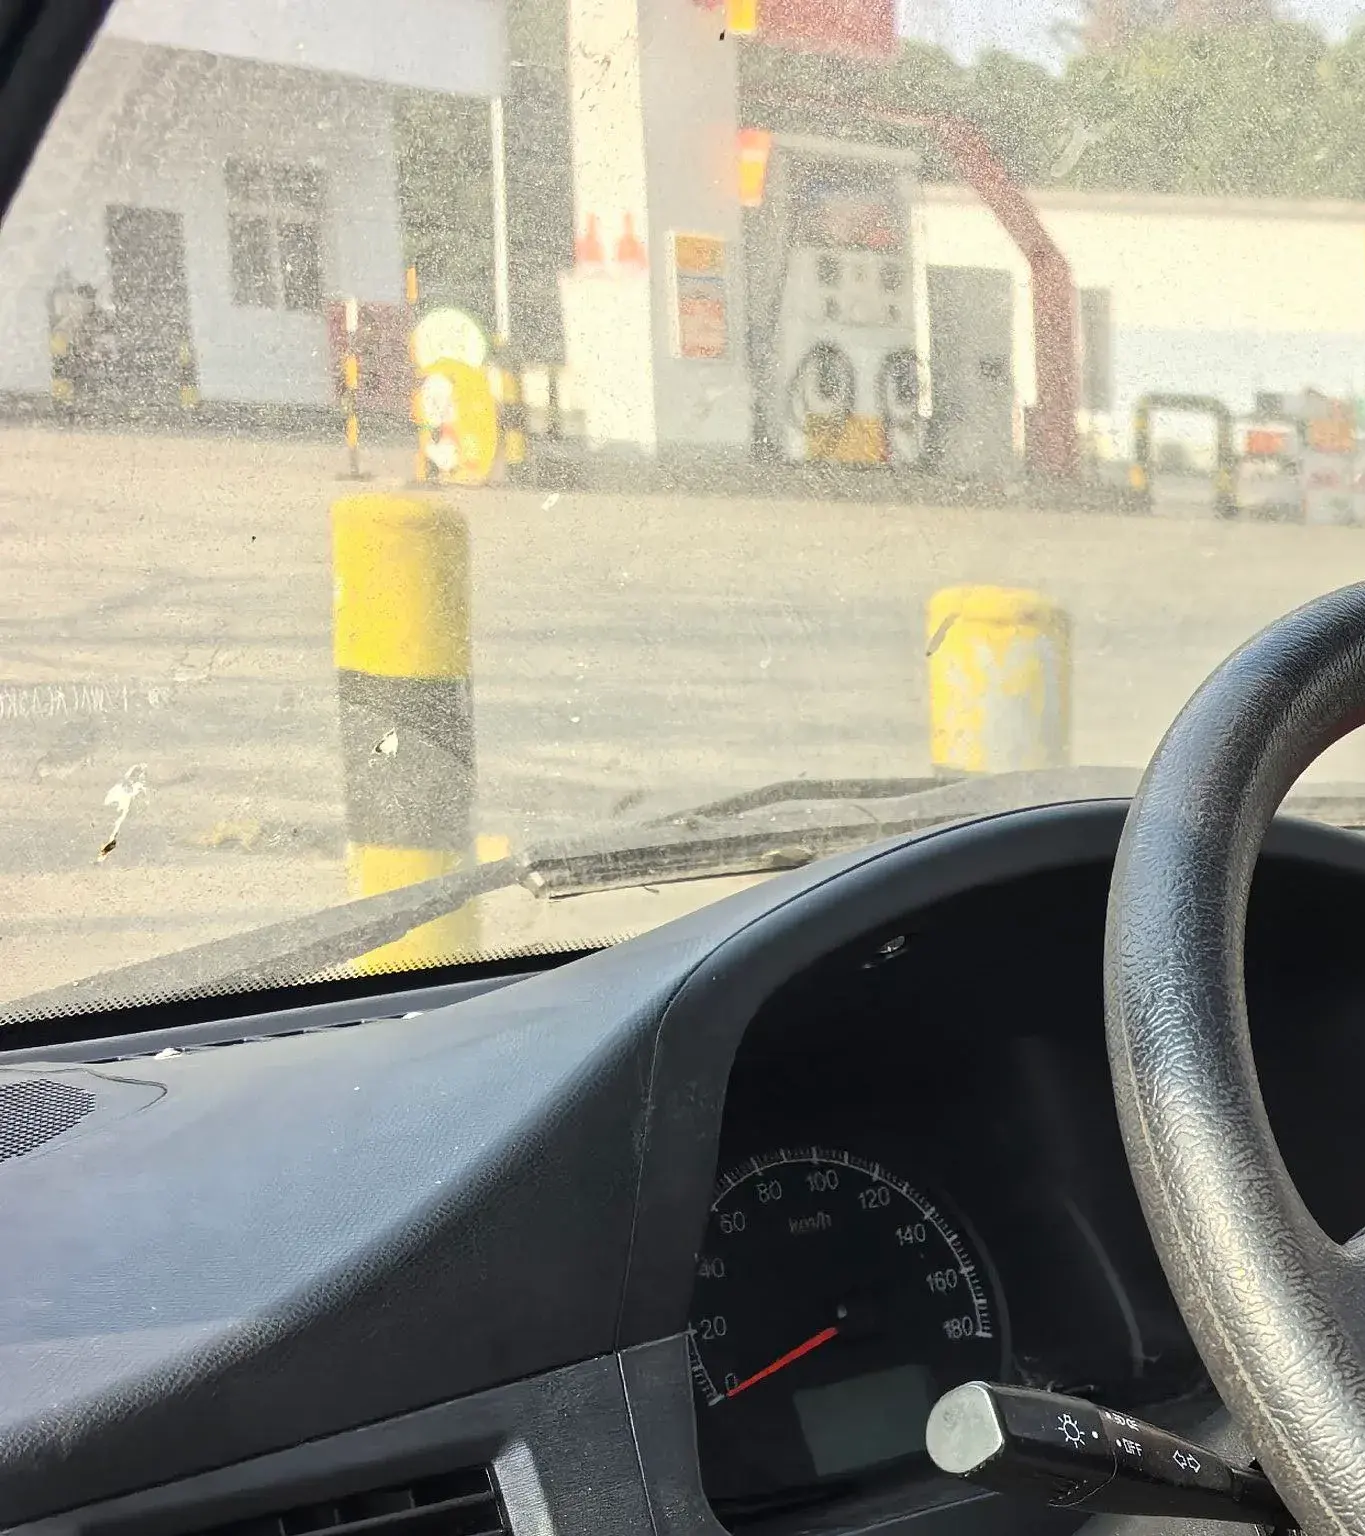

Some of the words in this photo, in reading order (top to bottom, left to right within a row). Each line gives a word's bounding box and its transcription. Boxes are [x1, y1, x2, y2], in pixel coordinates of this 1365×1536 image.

[756, 1180, 783, 1204] 80
[805, 1170, 839, 1192] 100
[857, 1186, 891, 1210] 120
[719, 1210, 747, 1234] 60
[895, 1222, 926, 1247] 140
[925, 1268, 958, 1293] 160
[699, 1315, 727, 1340] 20
[942, 1316, 973, 1339] 180
[1122, 1438, 1143, 1457] OFF
